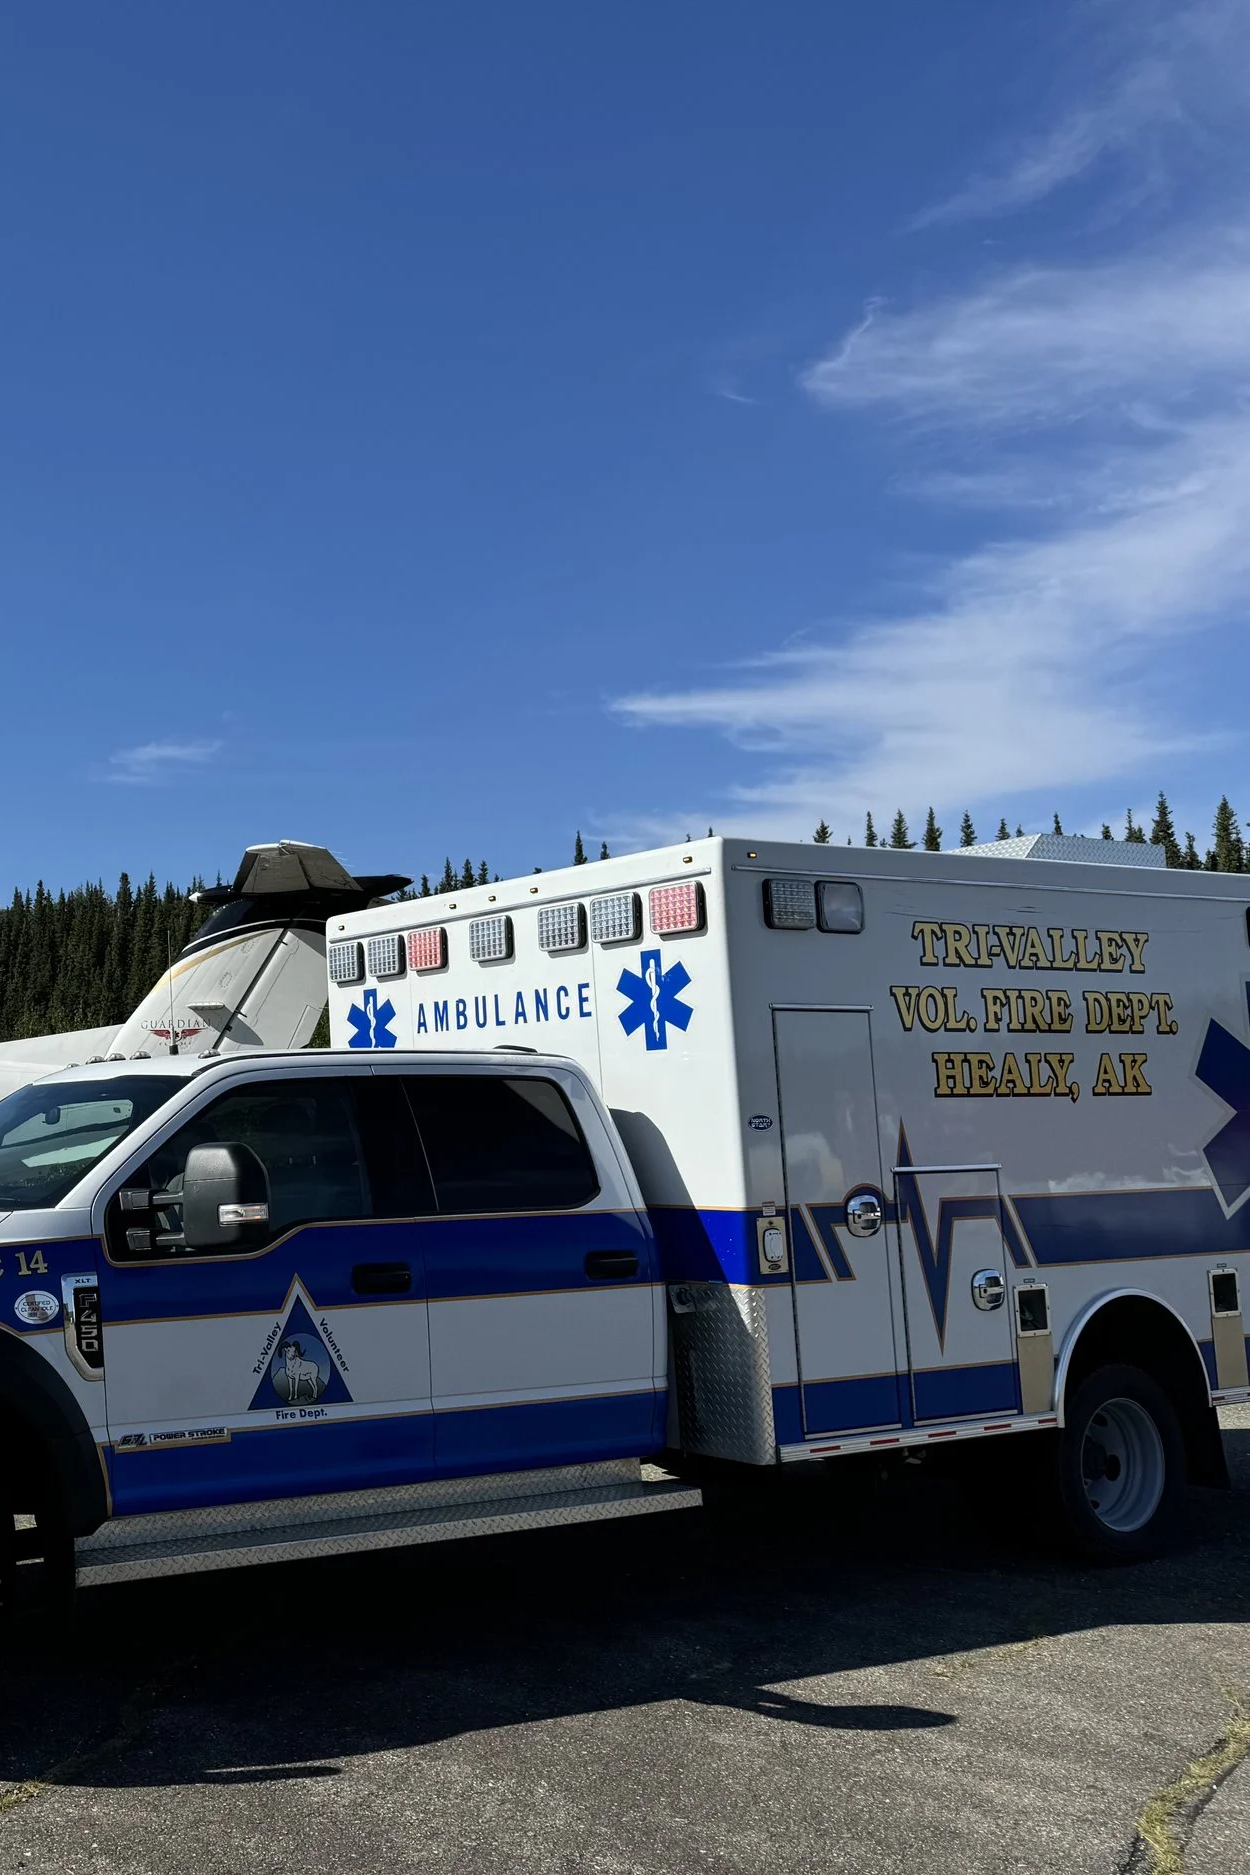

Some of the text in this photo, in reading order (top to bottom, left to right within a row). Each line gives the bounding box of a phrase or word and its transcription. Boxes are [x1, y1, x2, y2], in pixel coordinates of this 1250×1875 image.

[911, 921, 1149, 974] TRI-VALLEY
[417, 982, 592, 1034] AMBULANCE
[890, 985, 1179, 1035] VOL. FIRE DEPT.
[932, 1052, 1152, 1104] HEALY, AK
[14, 1250, 48, 1276] 14
[78, 1293, 99, 1352] F450
[252, 1321, 282, 1375] Tri-Valley
[319, 1317, 350, 1373] Volunteer
[153, 1433, 186, 1441] POWER
[188, 1428, 225, 1438] STROKE
[275, 1408, 328, 1420] Fire Dept.
